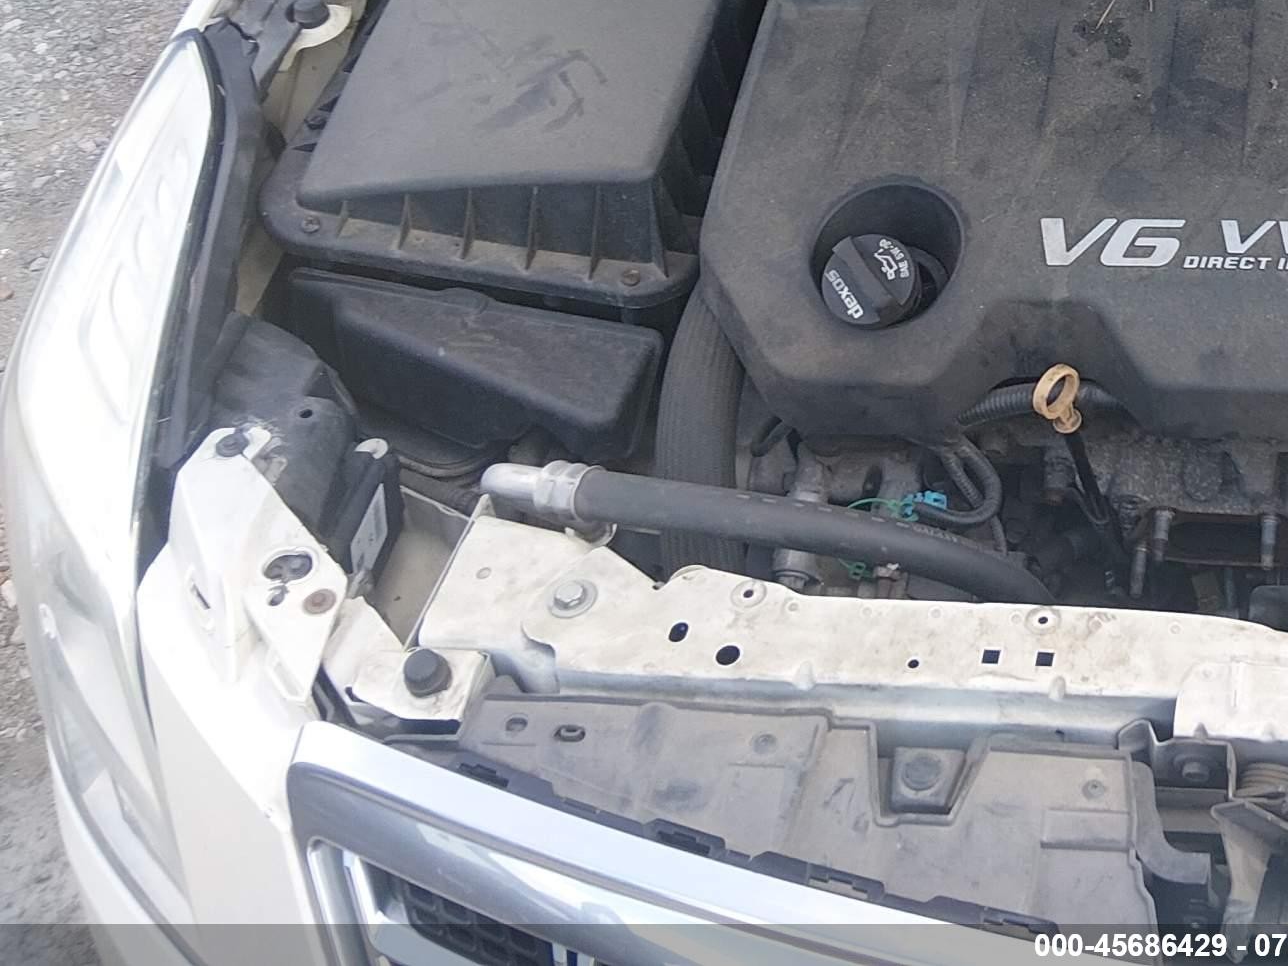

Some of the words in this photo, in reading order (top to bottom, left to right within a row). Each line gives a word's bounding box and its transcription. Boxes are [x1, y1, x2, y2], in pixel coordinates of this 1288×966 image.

[1040, 217, 1187, 267] V6
[898, 260, 910, 278] SAE
[1183, 255, 1273, 271] DIRECT
[823, 269, 864, 319] dexos
